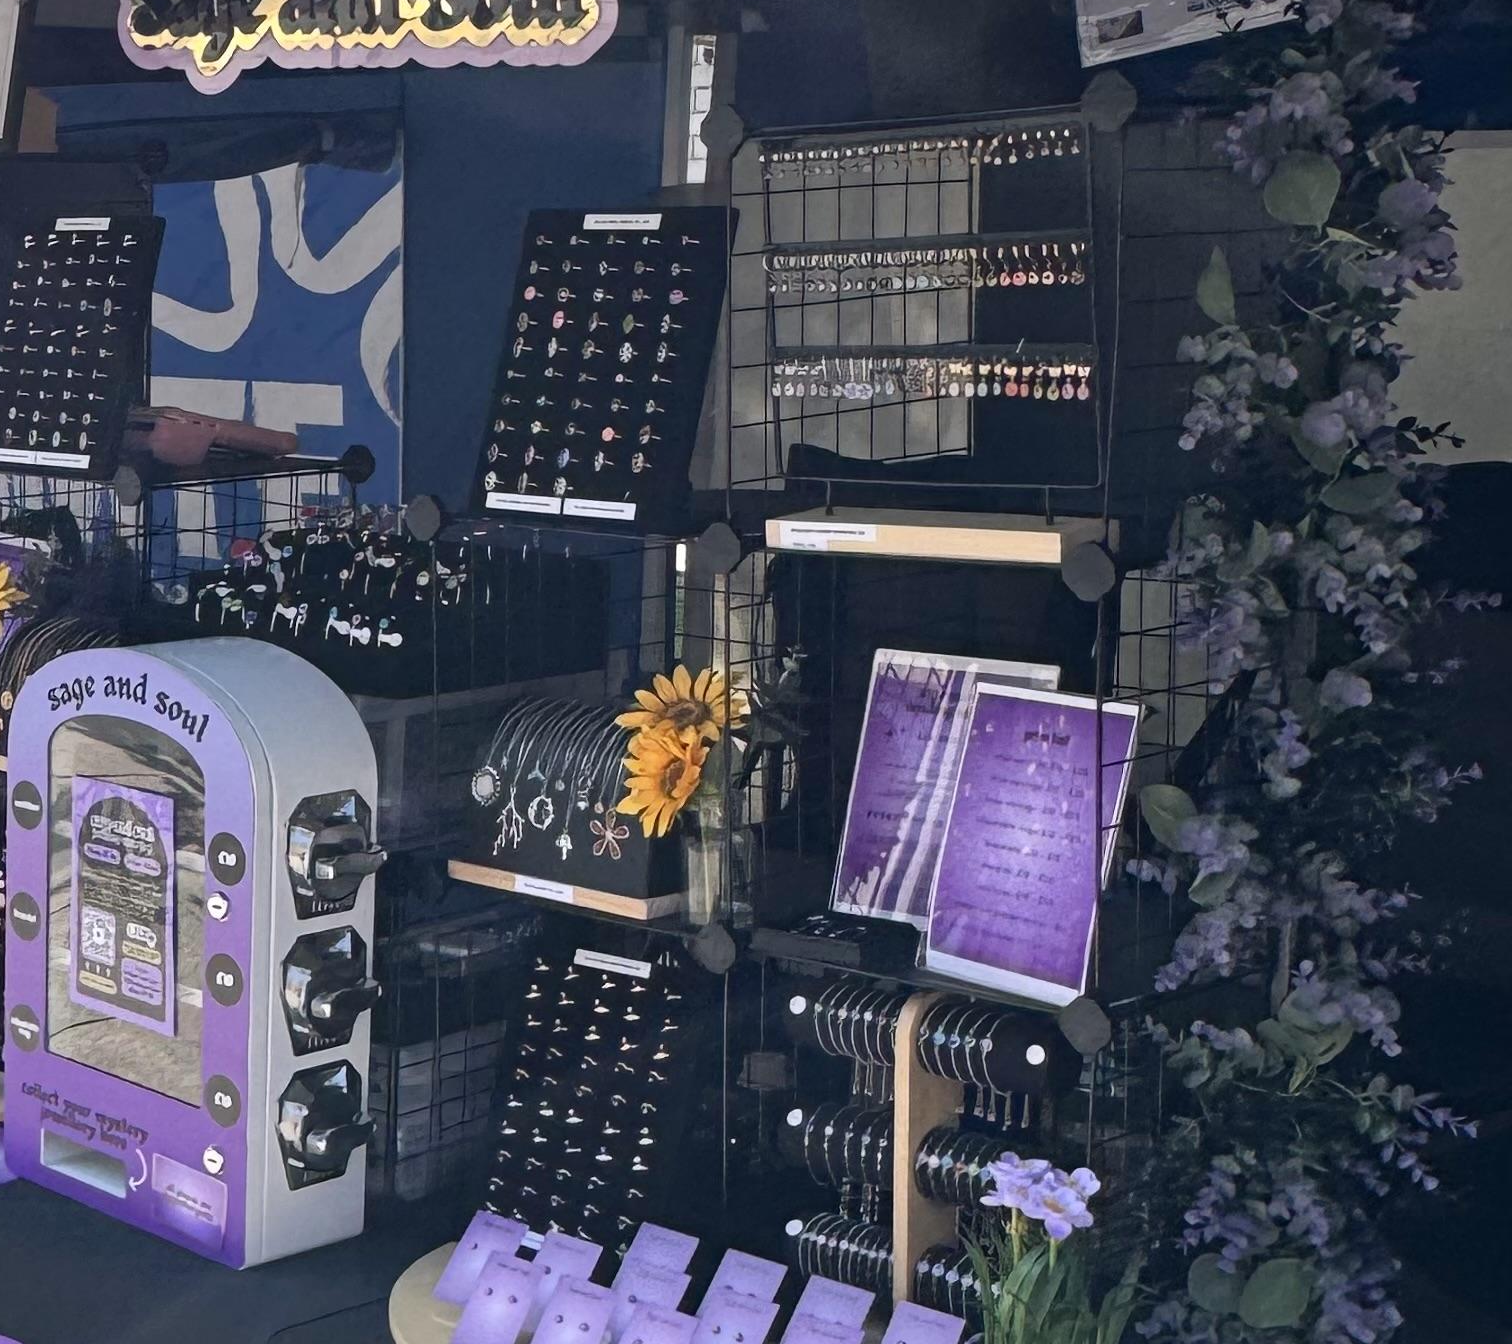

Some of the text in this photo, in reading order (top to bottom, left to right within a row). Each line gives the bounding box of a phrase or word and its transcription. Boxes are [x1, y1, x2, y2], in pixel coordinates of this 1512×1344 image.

[47, 673, 210, 743] sage and soul
